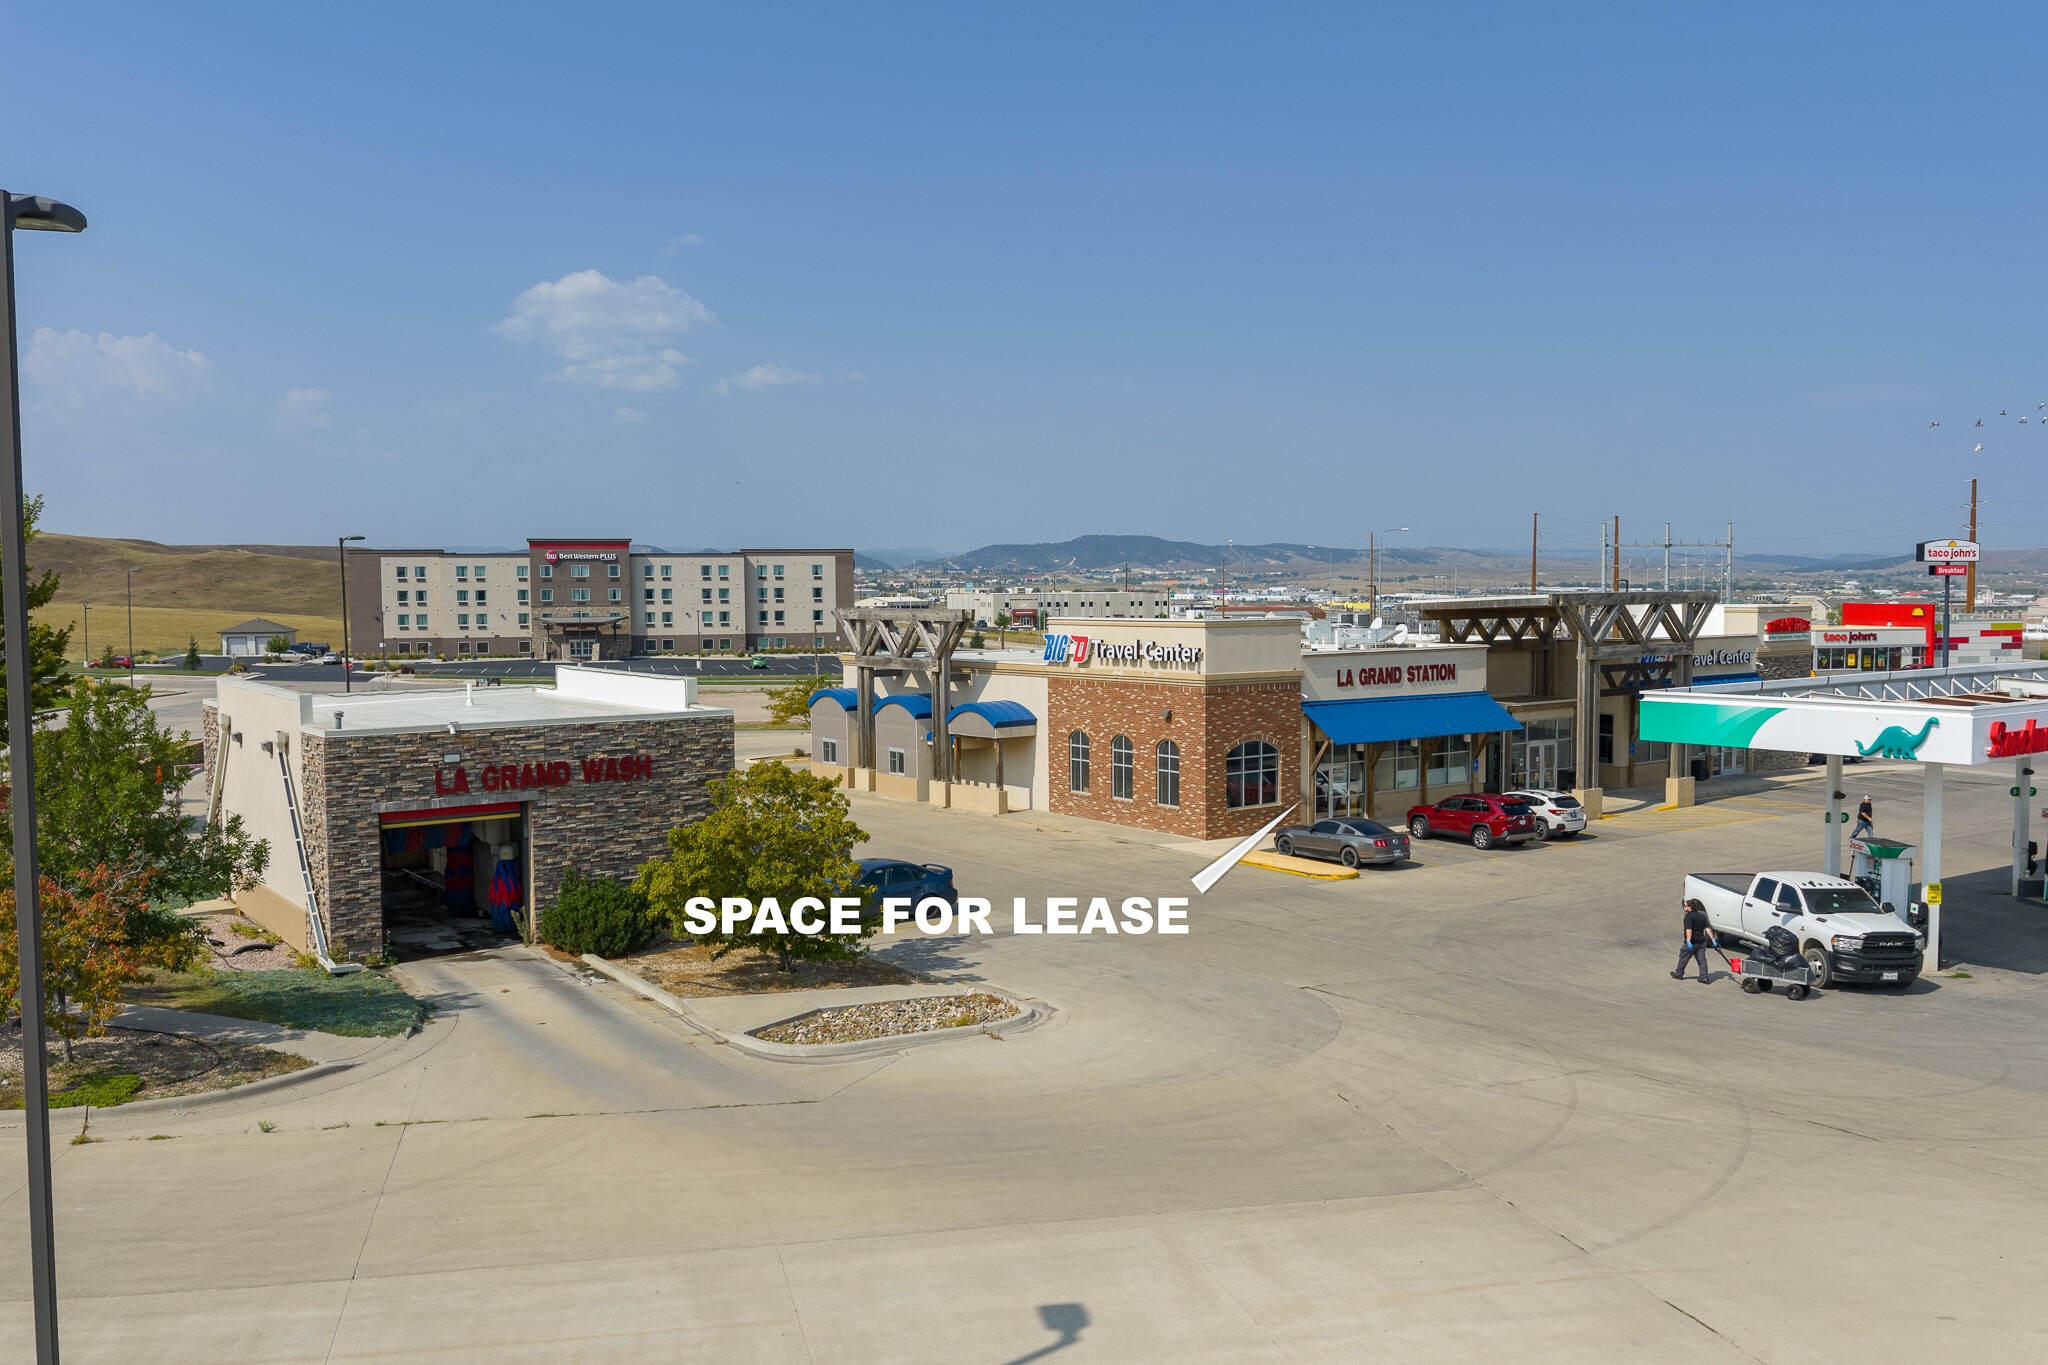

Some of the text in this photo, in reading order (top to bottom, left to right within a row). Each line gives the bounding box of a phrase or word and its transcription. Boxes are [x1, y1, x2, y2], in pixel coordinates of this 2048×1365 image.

[1928, 548, 1976, 559] taco john's
[1823, 631, 1878, 644] taco john's
[1043, 634, 1201, 663] BIG D Travel Center
[1692, 649, 1717, 667] avel
[1719, 649, 1755, 666] Center
[1337, 664, 1456, 687] LA GRAND STATION
[435, 755, 651, 795] LA GRAND WASH
